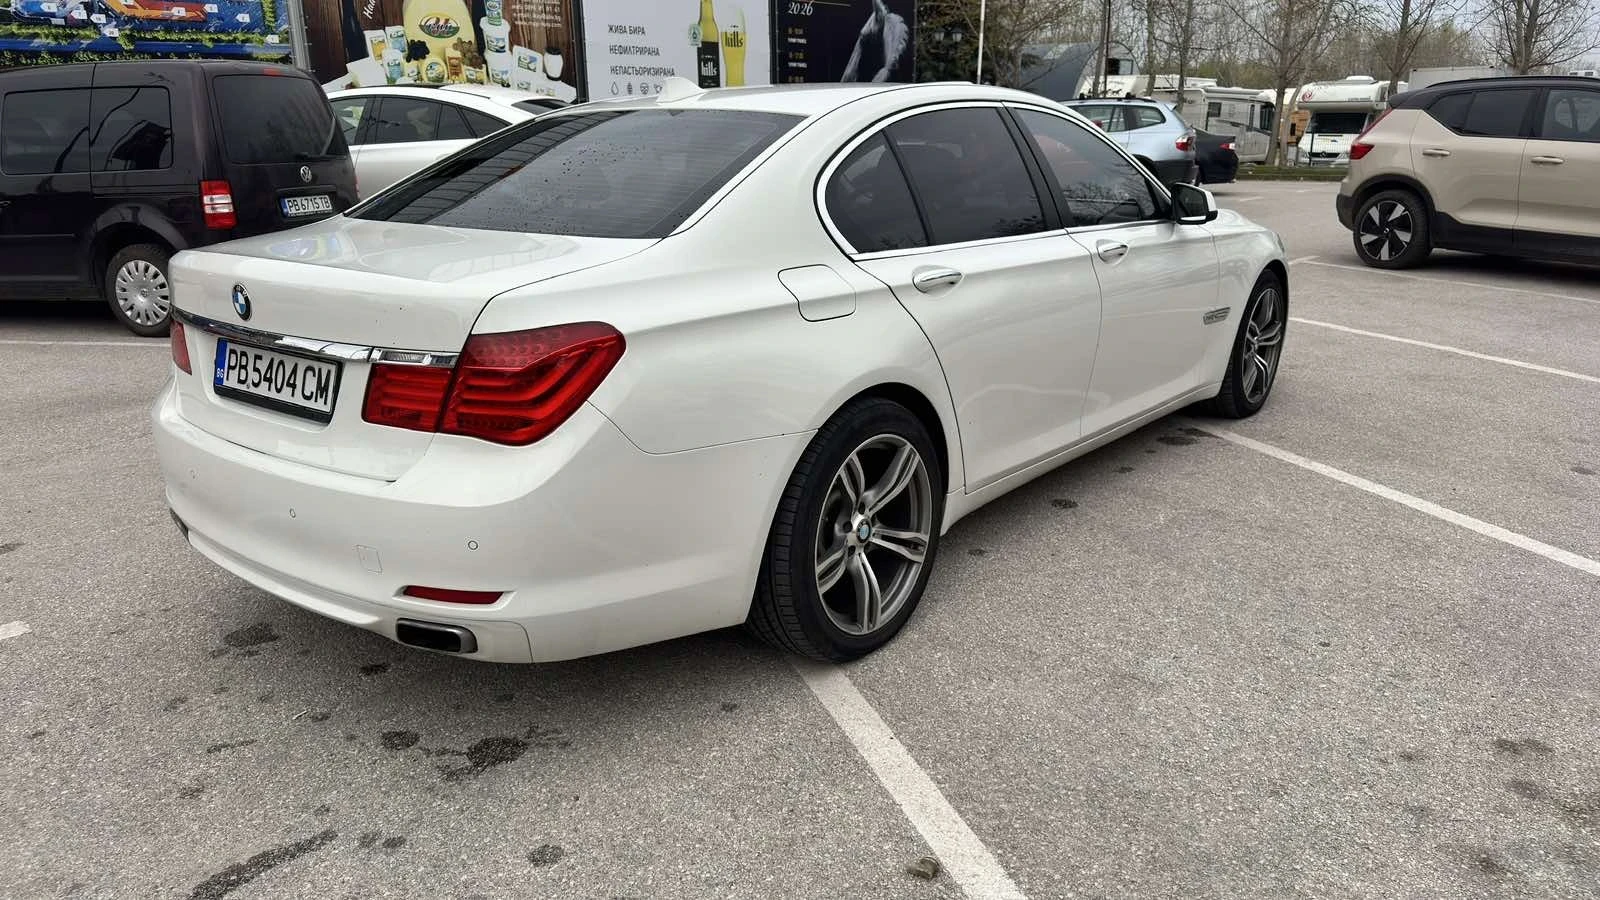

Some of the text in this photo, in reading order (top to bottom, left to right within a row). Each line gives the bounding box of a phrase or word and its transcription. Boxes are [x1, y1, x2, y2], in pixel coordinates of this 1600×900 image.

[787, 1, 814, 16] 2026
[608, 24, 646, 36] ЖИВА БИРА
[725, 31, 744, 48] hills
[609, 44, 660, 56] НЕФИЛТРИРАНА
[610, 65, 675, 77] НЕПАСТЬОРИЗИРАНА
[701, 61, 718, 76] hills
[287, 196, 331, 212] PB 6715 TB
[226, 348, 331, 405] PB 5404 CM
